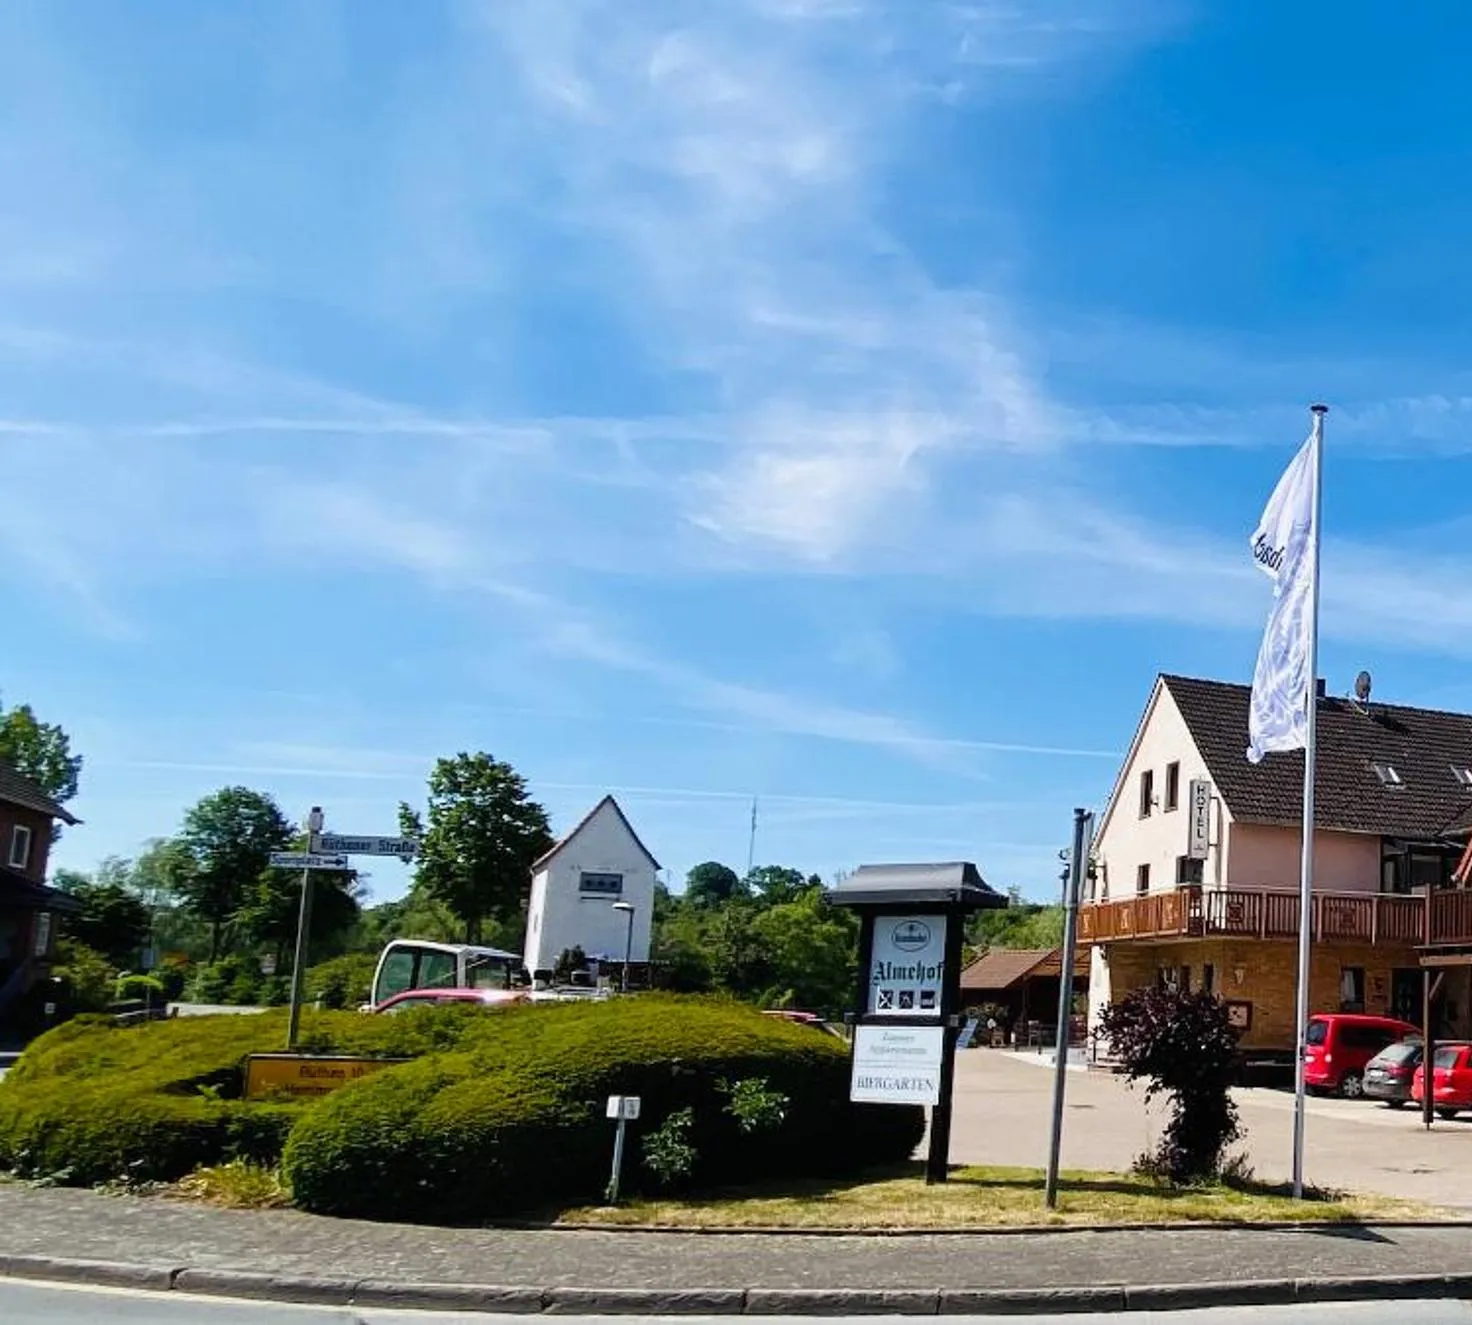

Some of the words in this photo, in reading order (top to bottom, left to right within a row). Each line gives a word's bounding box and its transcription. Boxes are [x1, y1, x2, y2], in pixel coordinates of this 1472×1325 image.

[1196, 784, 1206, 839] HOTEL
[379, 838, 416, 853] Straße
[873, 960, 945, 986] Almehof
[857, 1076, 935, 1092] BIERGARTEN
